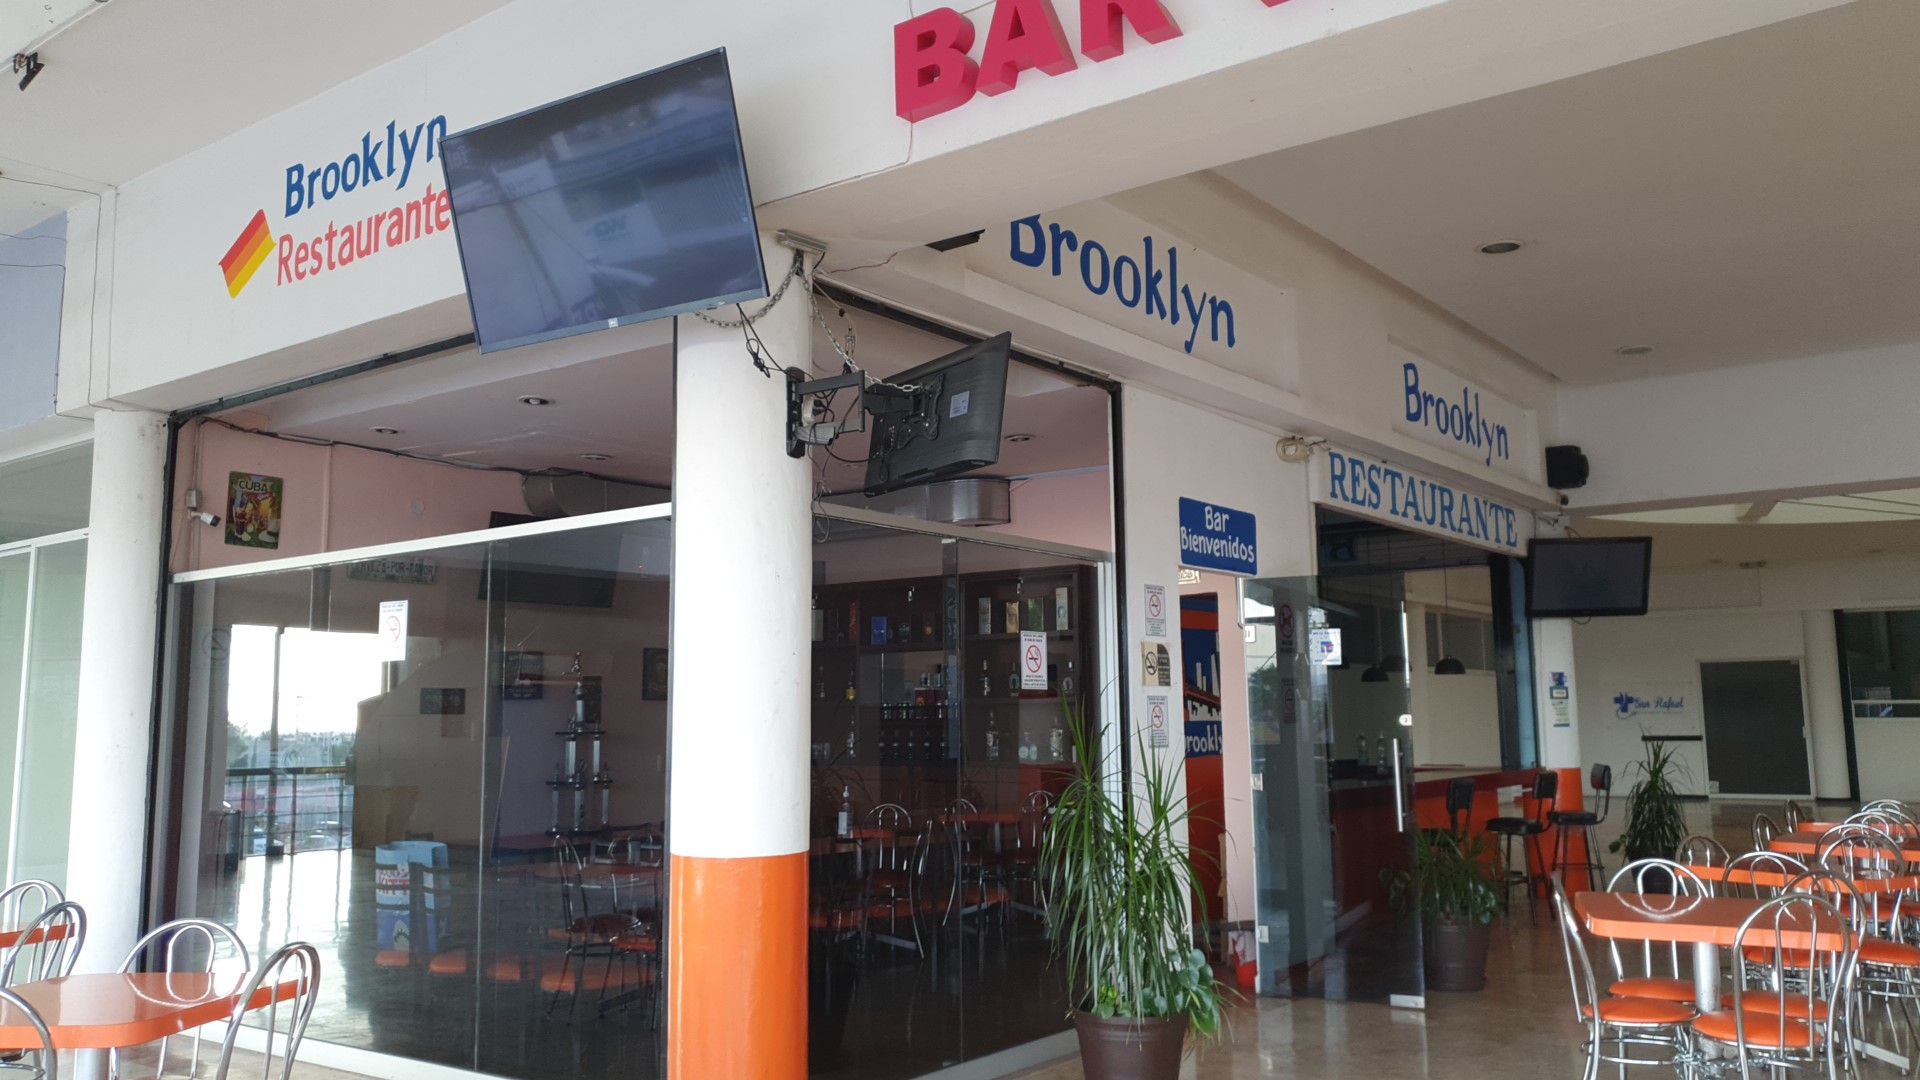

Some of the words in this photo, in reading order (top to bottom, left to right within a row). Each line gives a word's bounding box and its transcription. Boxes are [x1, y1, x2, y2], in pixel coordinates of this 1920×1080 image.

[285, 115, 447, 218] Brooklyn
[277, 183, 451, 286] Restaurante
[1010, 214, 1236, 354] Brooklyn
[1403, 362, 1509, 467] Brooklyn
[239, 480, 268, 492] CUBA
[1204, 505, 1230, 533] Bar
[1329, 451, 1518, 548] RESTAURANTE
[1180, 526, 1255, 563] Bienvenidos
